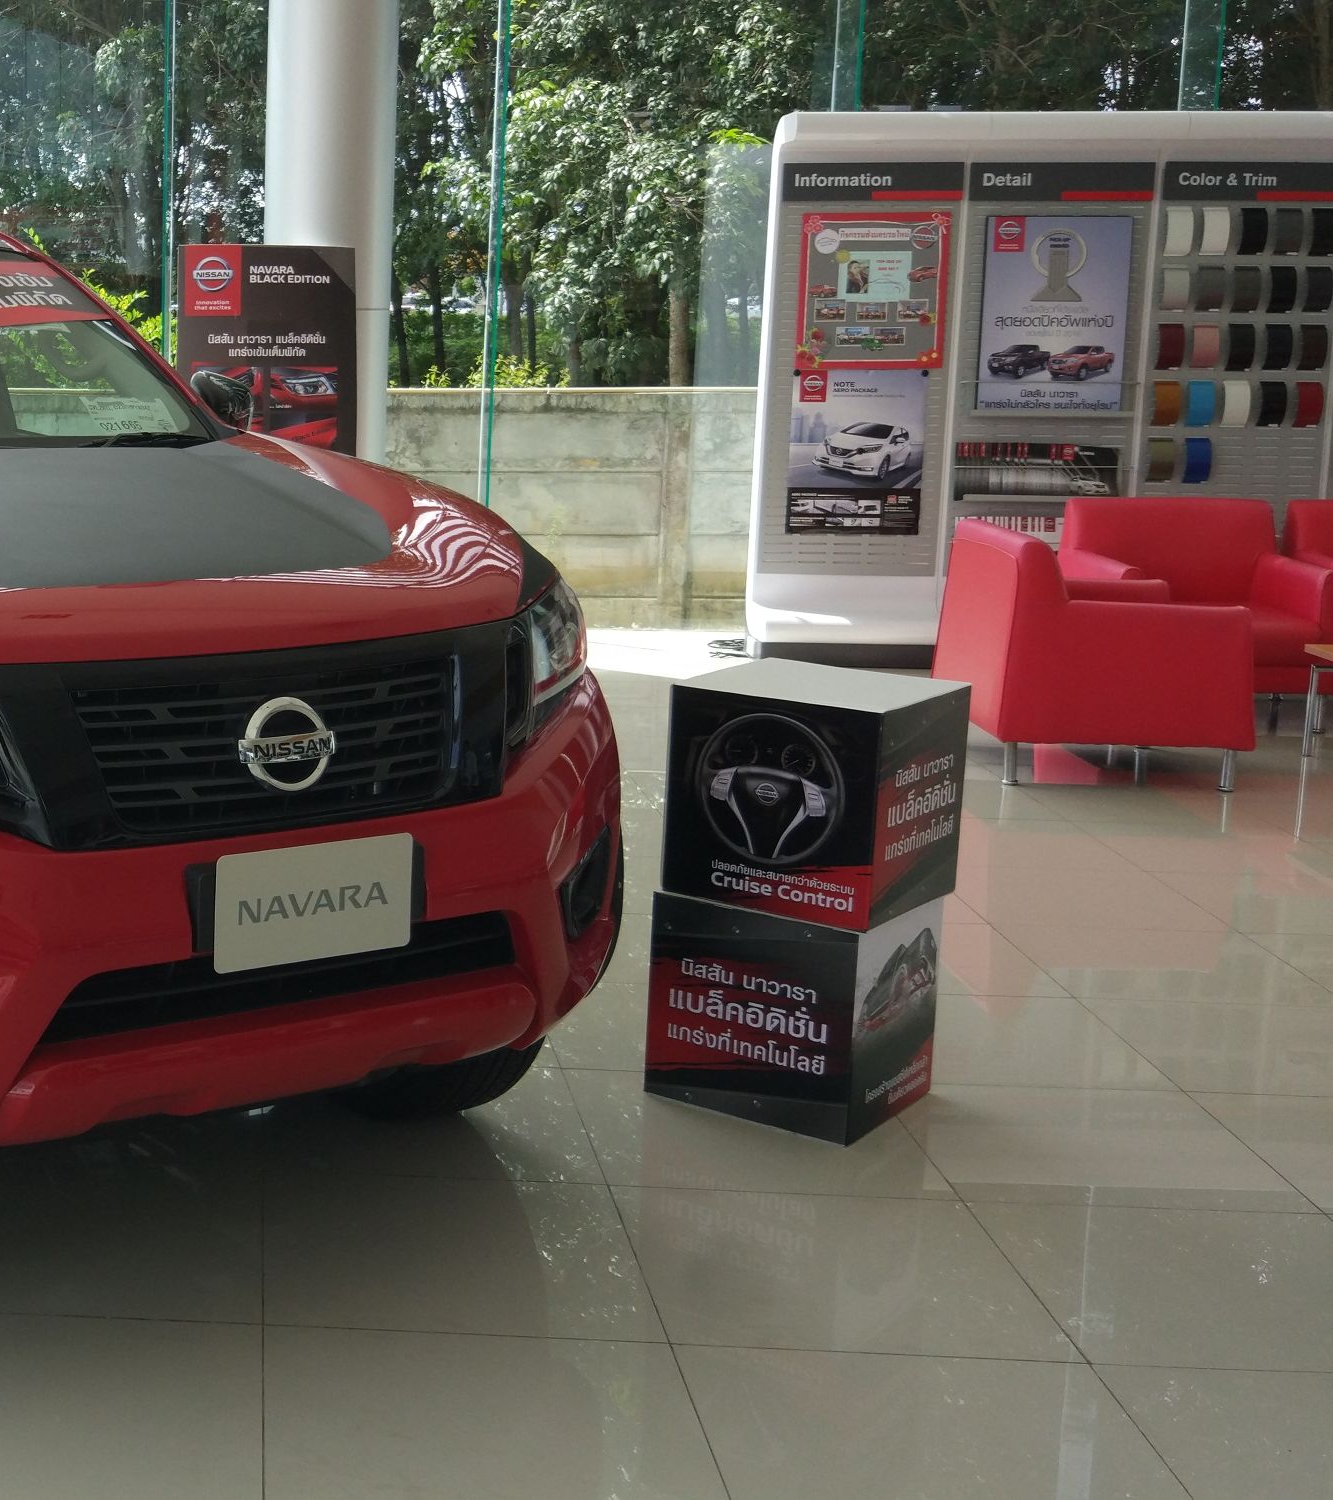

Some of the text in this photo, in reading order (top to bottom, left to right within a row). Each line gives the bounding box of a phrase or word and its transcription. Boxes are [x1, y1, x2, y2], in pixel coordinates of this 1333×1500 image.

[793, 173, 892, 187] Information
[982, 172, 1032, 187] Detail
[1178, 172, 1277, 187] Color & Trim
[249, 265, 295, 274] NAVARA
[249, 274, 330, 284] BLACK EDITION
[207, 332, 234, 345] นิสสัน
[237, 334, 272, 345] นาวารา
[228, 346, 306, 357] แกร่งเข้มเต็มพิกัด
[253, 735, 332, 758] NISSAN
[895, 753, 954, 788] นิสสัน นาวารา
[884, 813, 955, 861] แกร่งที่เทคโนโลยี
[710, 871, 853, 913] Cruise Control
[237, 881, 389, 926] NAVARA
[681, 957, 817, 1004] นิสสัน นาวารา
[667, 1022, 826, 1076] แกร่งที่เทคโนโลยี
